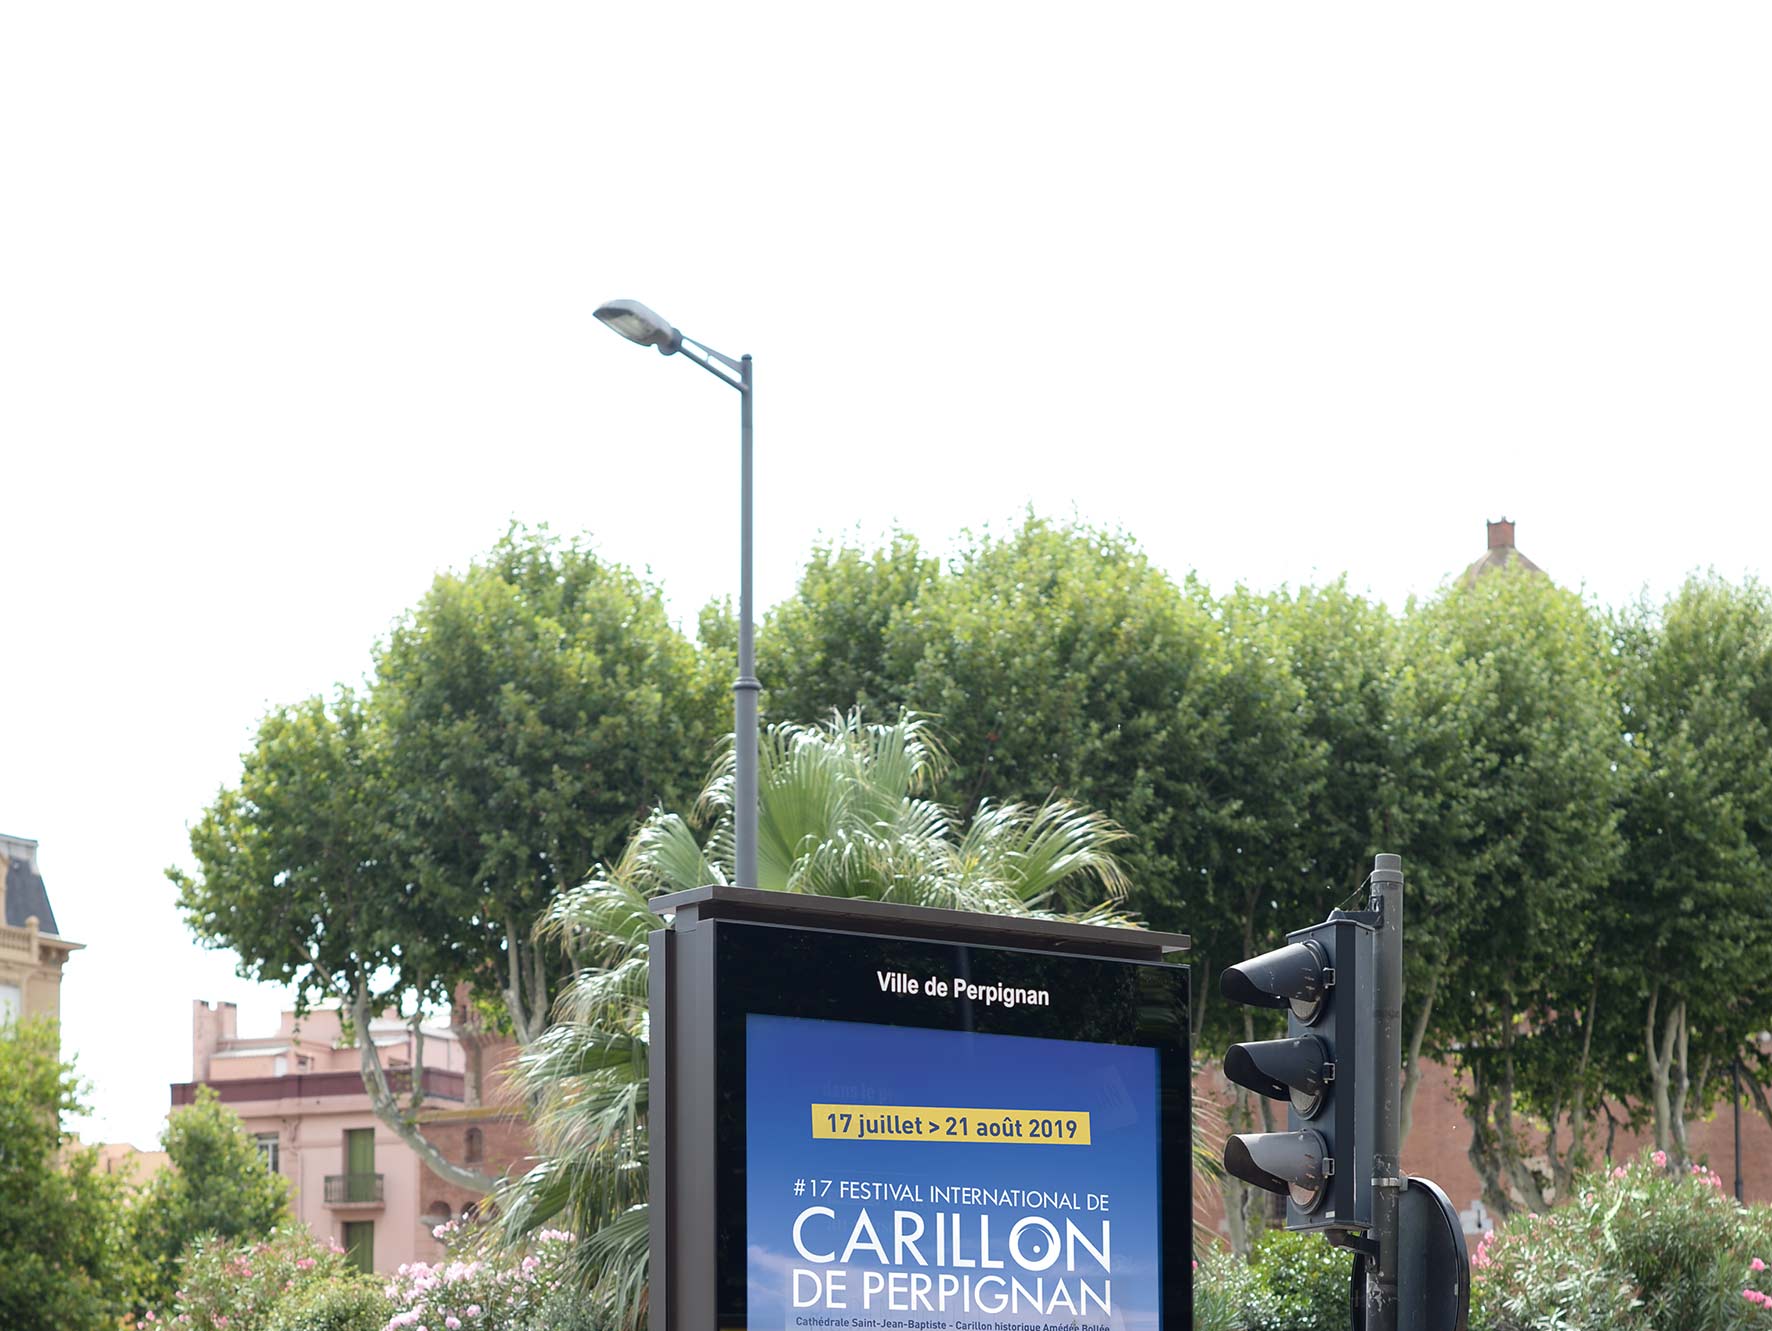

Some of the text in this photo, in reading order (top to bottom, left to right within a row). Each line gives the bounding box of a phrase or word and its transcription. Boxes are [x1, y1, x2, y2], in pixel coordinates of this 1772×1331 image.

[877, 971, 1049, 1008] Ville de Perpignan
[827, 1113, 852, 1133] 17
[858, 1114, 923, 1138] juillet
[945, 1117, 968, 1136] 21
[976, 1117, 1022, 1137] août
[1029, 1119, 1077, 1139] 2019
[840, 1181, 923, 1203] FESTIVAL
[930, 1186, 1080, 1210] INTERNATIONAL
[1087, 1194, 1109, 1212] DE
[792, 1206, 1111, 1274] CARILLON
[792, 1269, 1111, 1317] DE PERPIGNAN
[796, 1316, 849, 1328] Cathédrale
[852, 1318, 947, 1331] Saint-Jean-Baptiste
[955, 1320, 993, 1331] Carillon
